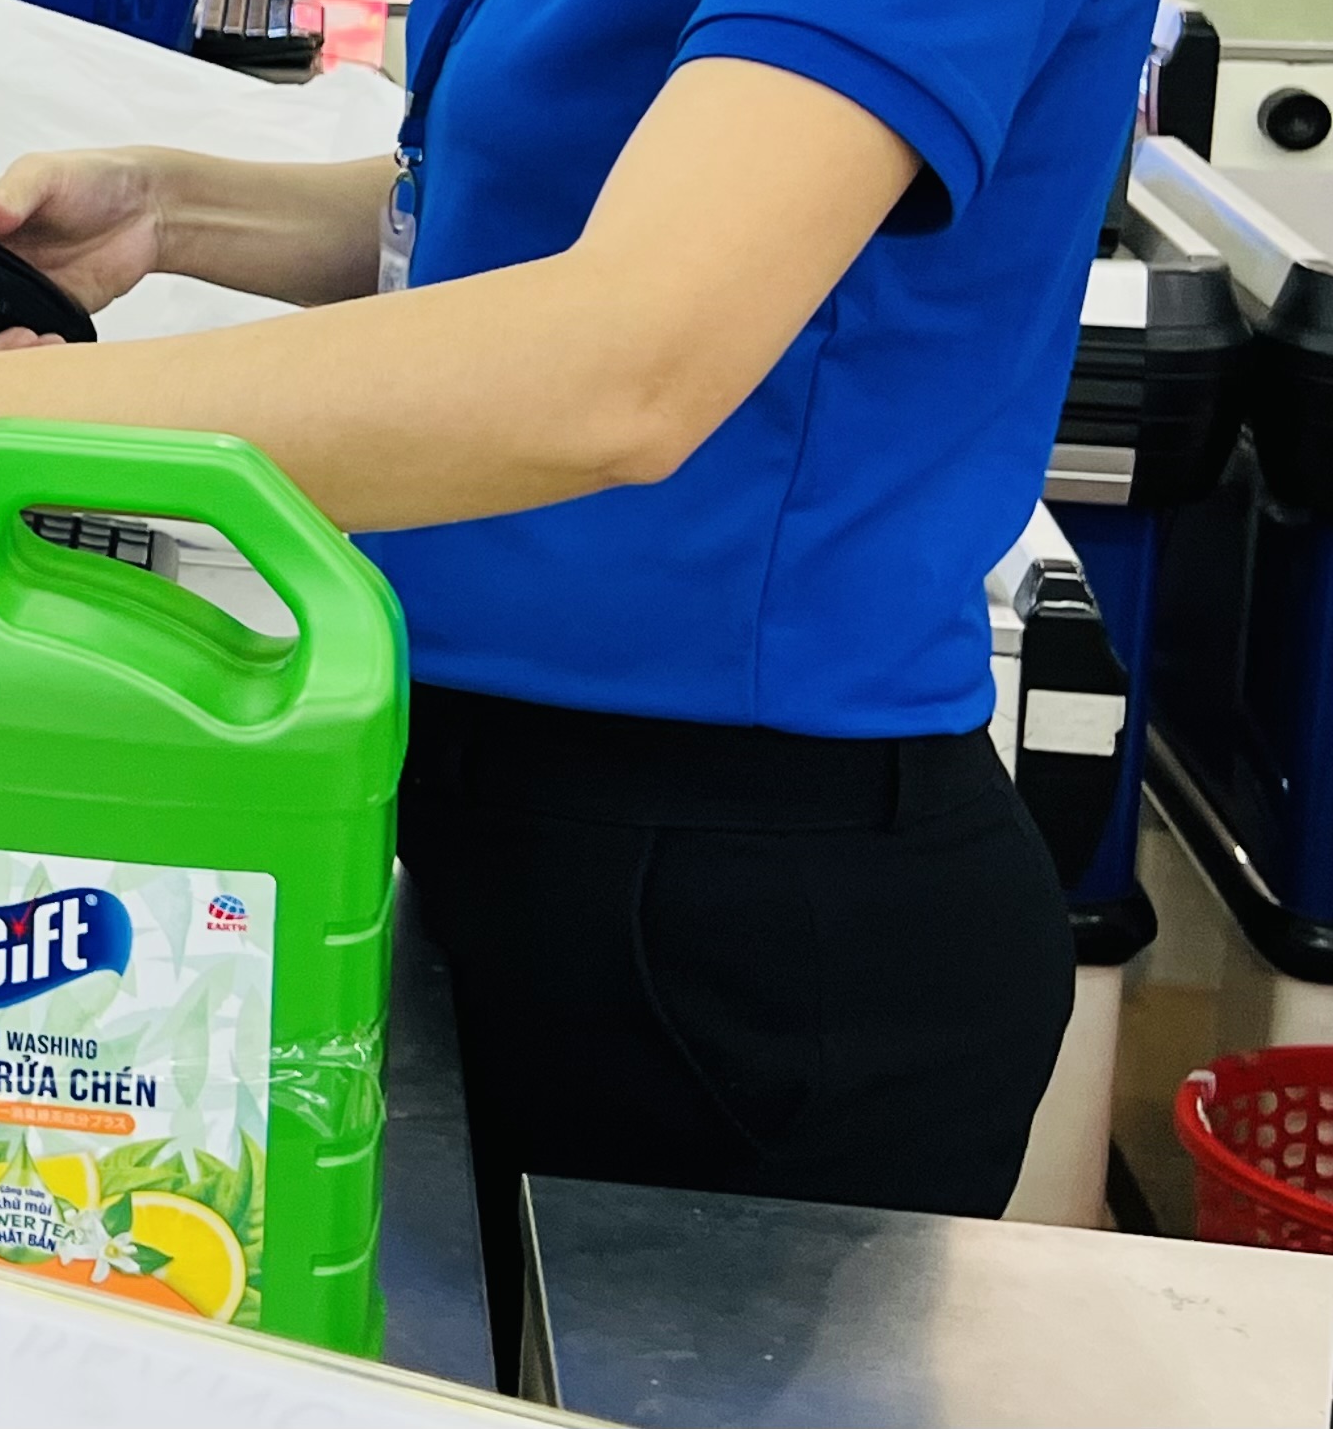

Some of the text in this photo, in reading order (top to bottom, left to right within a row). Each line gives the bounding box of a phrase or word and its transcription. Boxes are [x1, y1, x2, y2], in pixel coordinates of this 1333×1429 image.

[6, 1029, 99, 1061] WASHING
[69, 1065, 157, 1109] CHÉN
[24, 1200, 53, 1217] mùi
[40, 1218, 77, 1244] TEA
